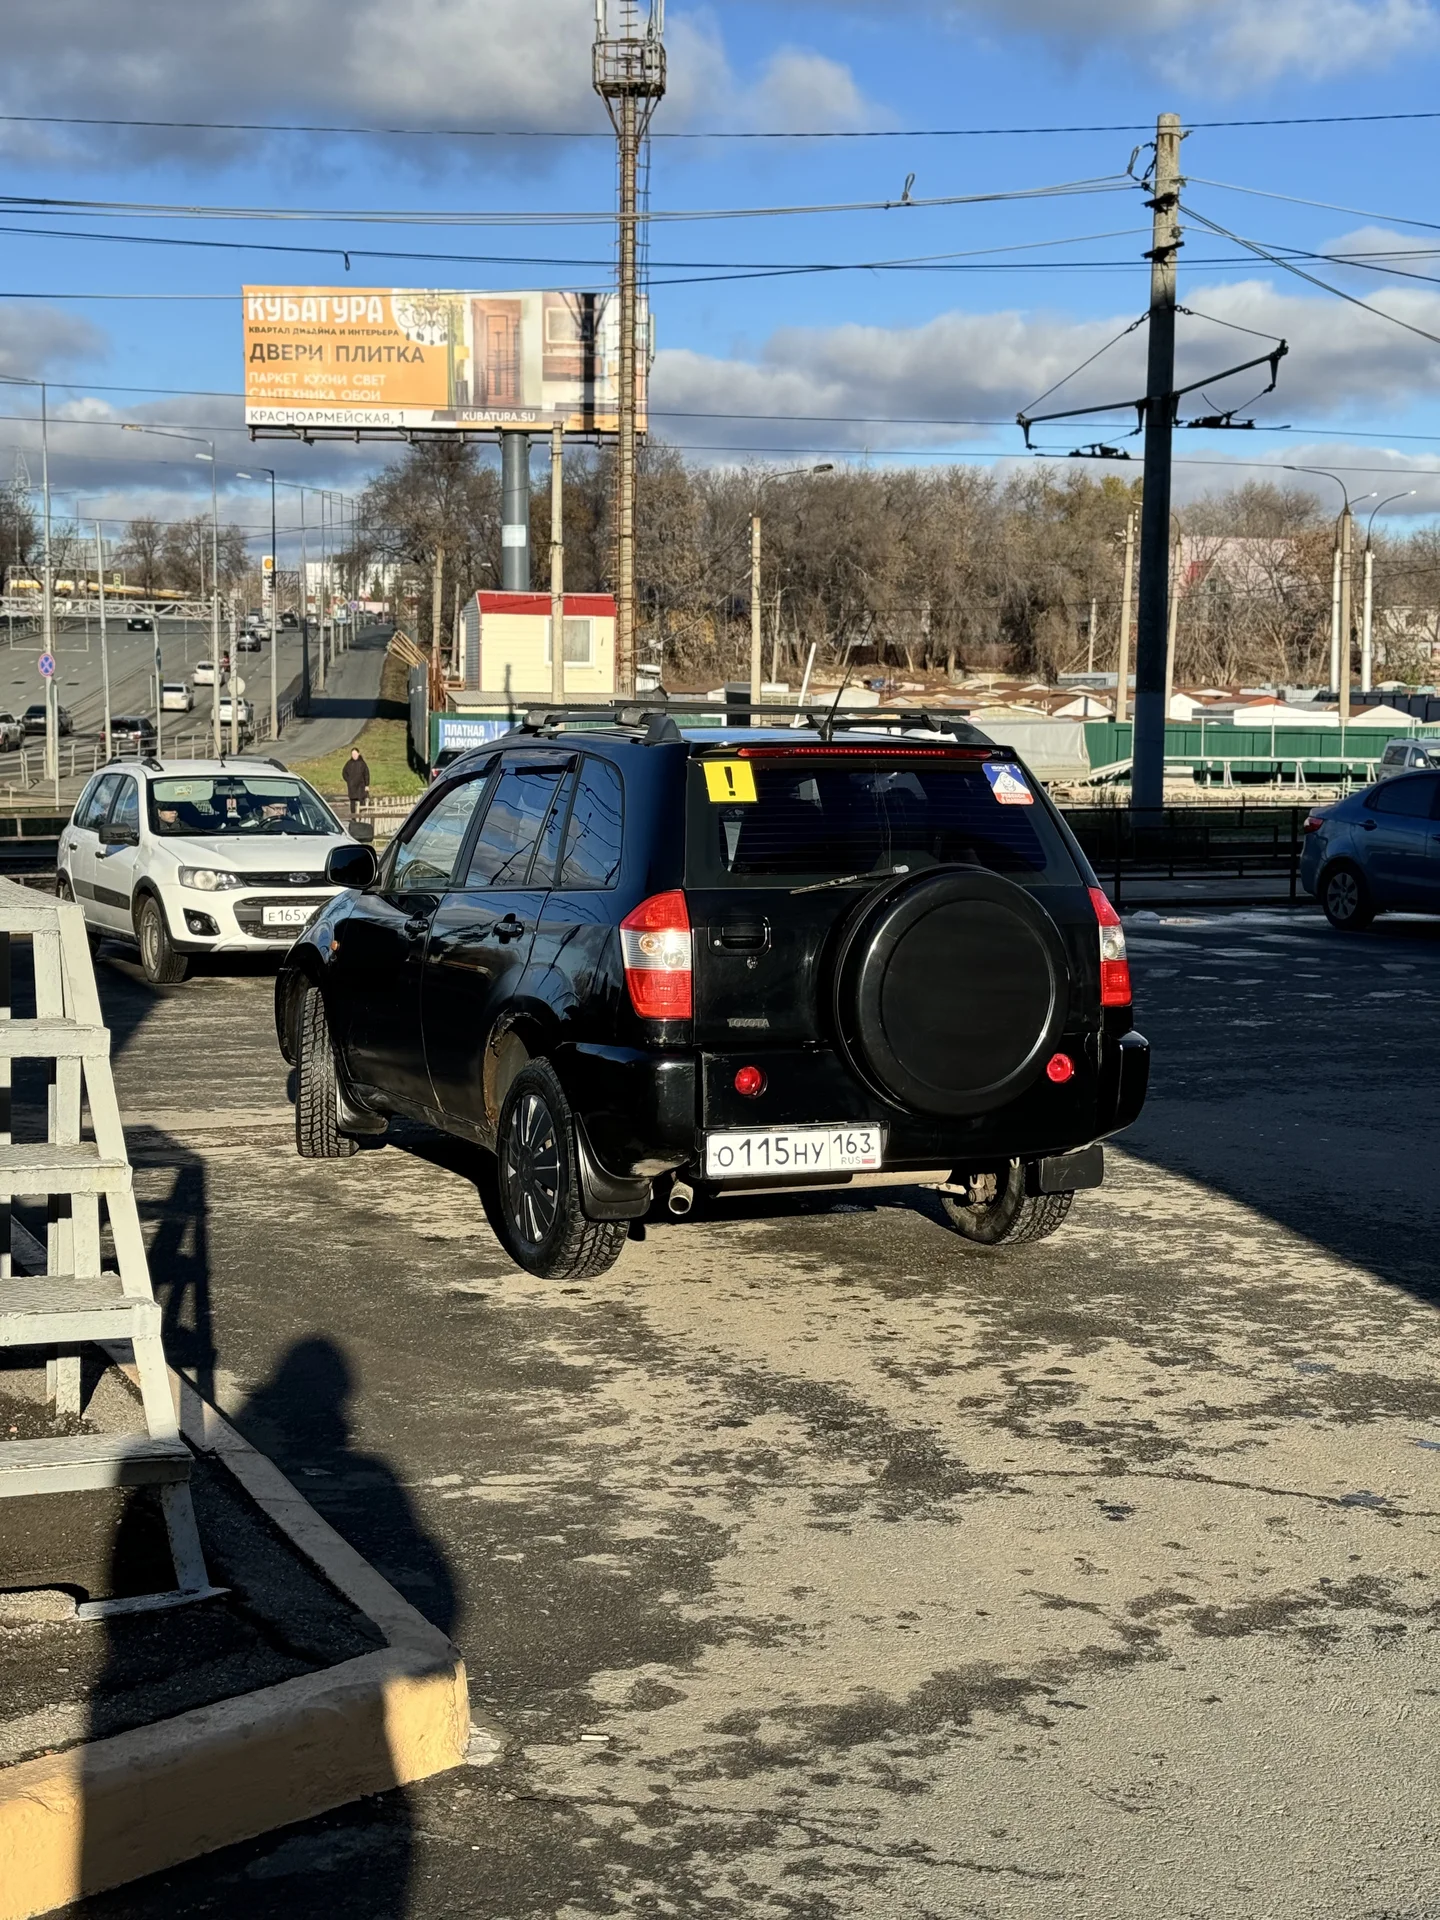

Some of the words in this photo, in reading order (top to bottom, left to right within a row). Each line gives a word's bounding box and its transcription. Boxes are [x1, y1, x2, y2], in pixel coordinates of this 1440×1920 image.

[247, 292, 384, 324] КУБАТУРА
[248, 326, 291, 335] КВАРТАЛ
[339, 328, 346, 336] И
[347, 328, 400, 337] ИНТЕРЬЕРА
[249, 343, 324, 363] ДВЕРИ
[335, 345, 426, 364] ПЛИТКА
[248, 371, 298, 385] ПАРКЕТ
[303, 373, 348, 386] КУХНИ
[352, 373, 387, 387] СВЕТ
[248, 387, 336, 401] САНТЕХНИКА
[340, 388, 382, 401] ОБОИ
[250, 409, 395, 425] КРАСНОАРМЕЙСКАЯ,
[398, 411, 405, 424] 1
[461, 410, 537, 423] KUBATURA.SU
[444, 723, 485, 737] ПЛАТНАЯ
[268, 909, 313, 922] Е165Х
[717, 1137, 825, 1167] О115НУ
[832, 1132, 872, 1156] 163
[840, 1156, 861, 1165] RUS
